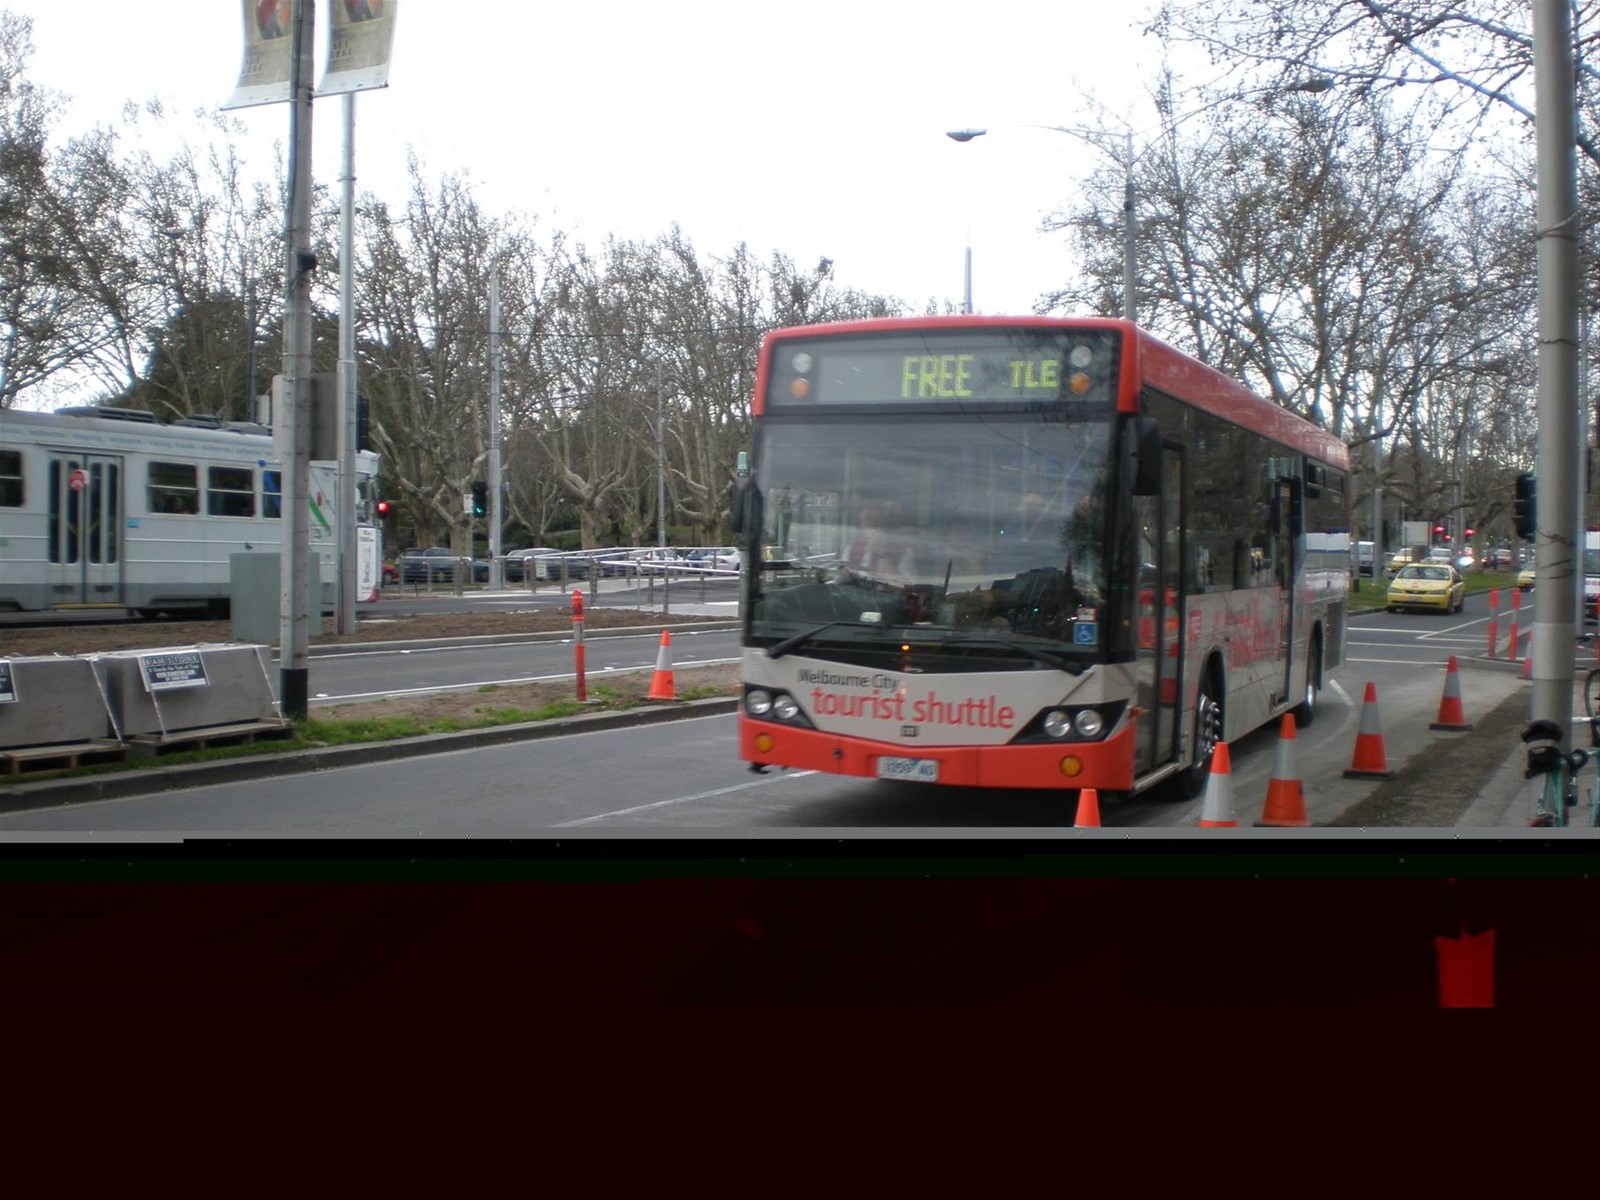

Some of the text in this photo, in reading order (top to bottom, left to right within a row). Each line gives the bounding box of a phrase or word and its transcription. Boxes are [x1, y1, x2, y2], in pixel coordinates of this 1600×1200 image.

[902, 354, 1059, 397] FREE TLE
[797, 669, 899, 692] Melbourne City
[811, 687, 1014, 729] tourist shuttle
